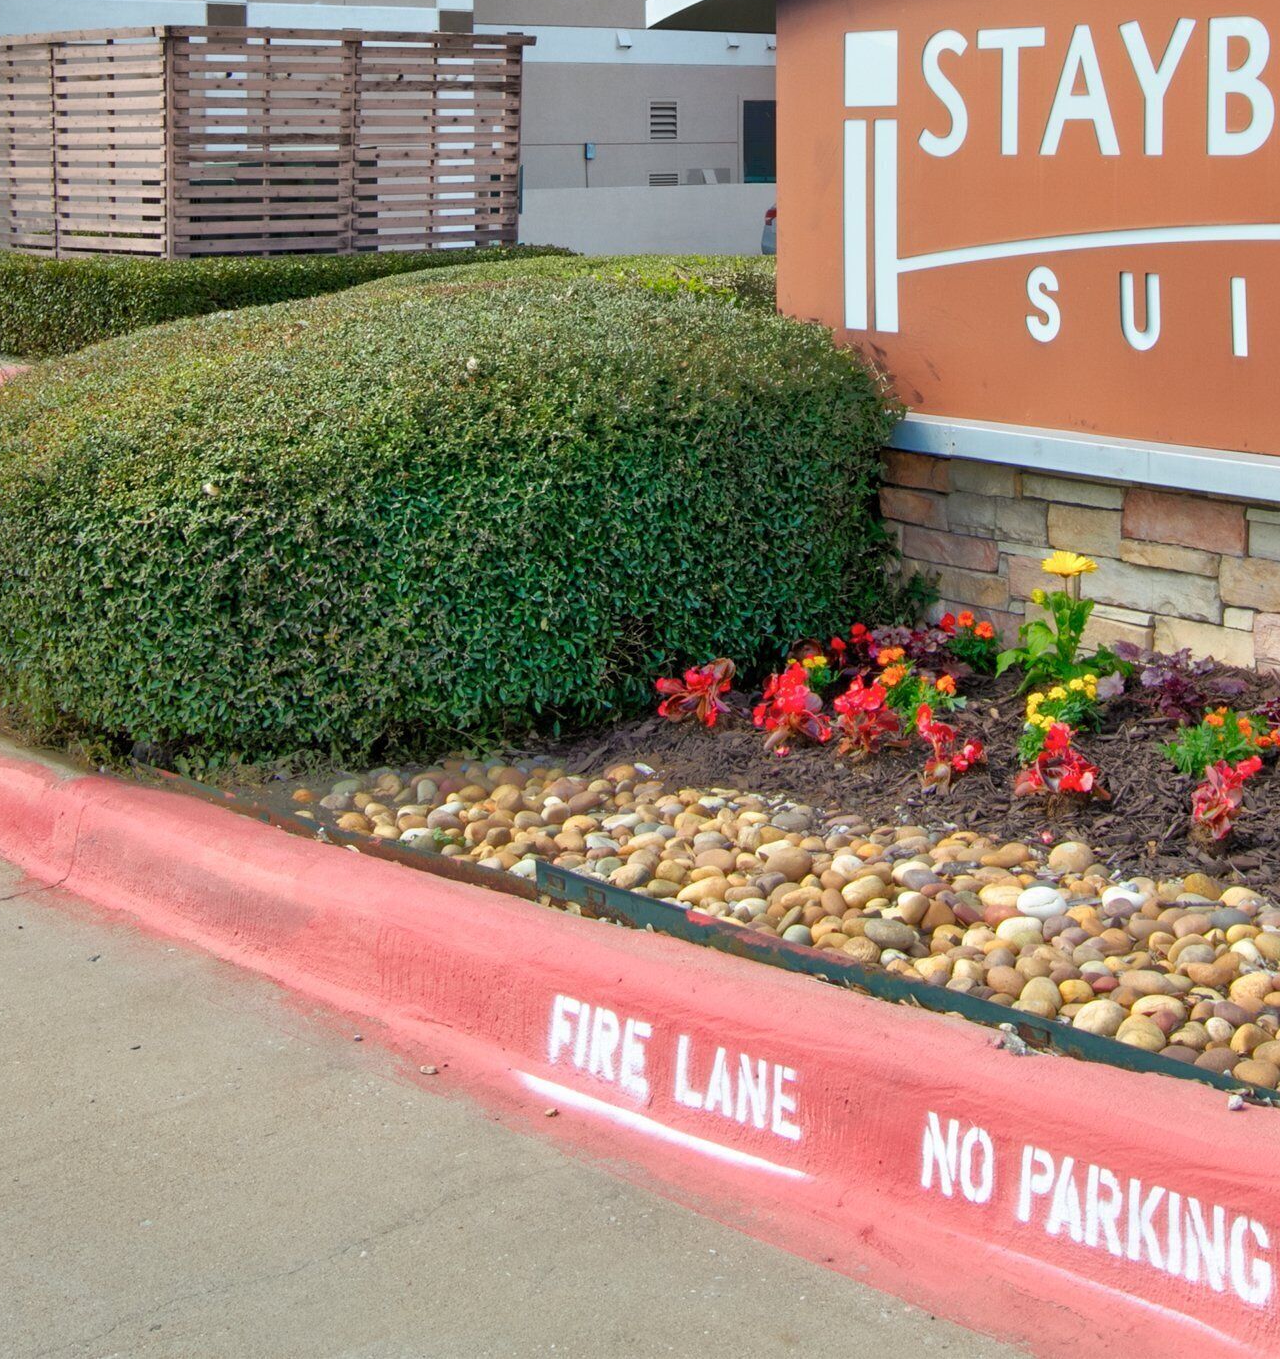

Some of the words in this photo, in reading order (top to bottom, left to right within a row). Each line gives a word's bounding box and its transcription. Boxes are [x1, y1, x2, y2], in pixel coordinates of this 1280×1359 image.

[547, 993, 652, 1098] FIRE
[673, 1033, 803, 1141] LANE
[920, 1110, 996, 1205] NO
[1016, 1144, 1274, 1307] PARKING
